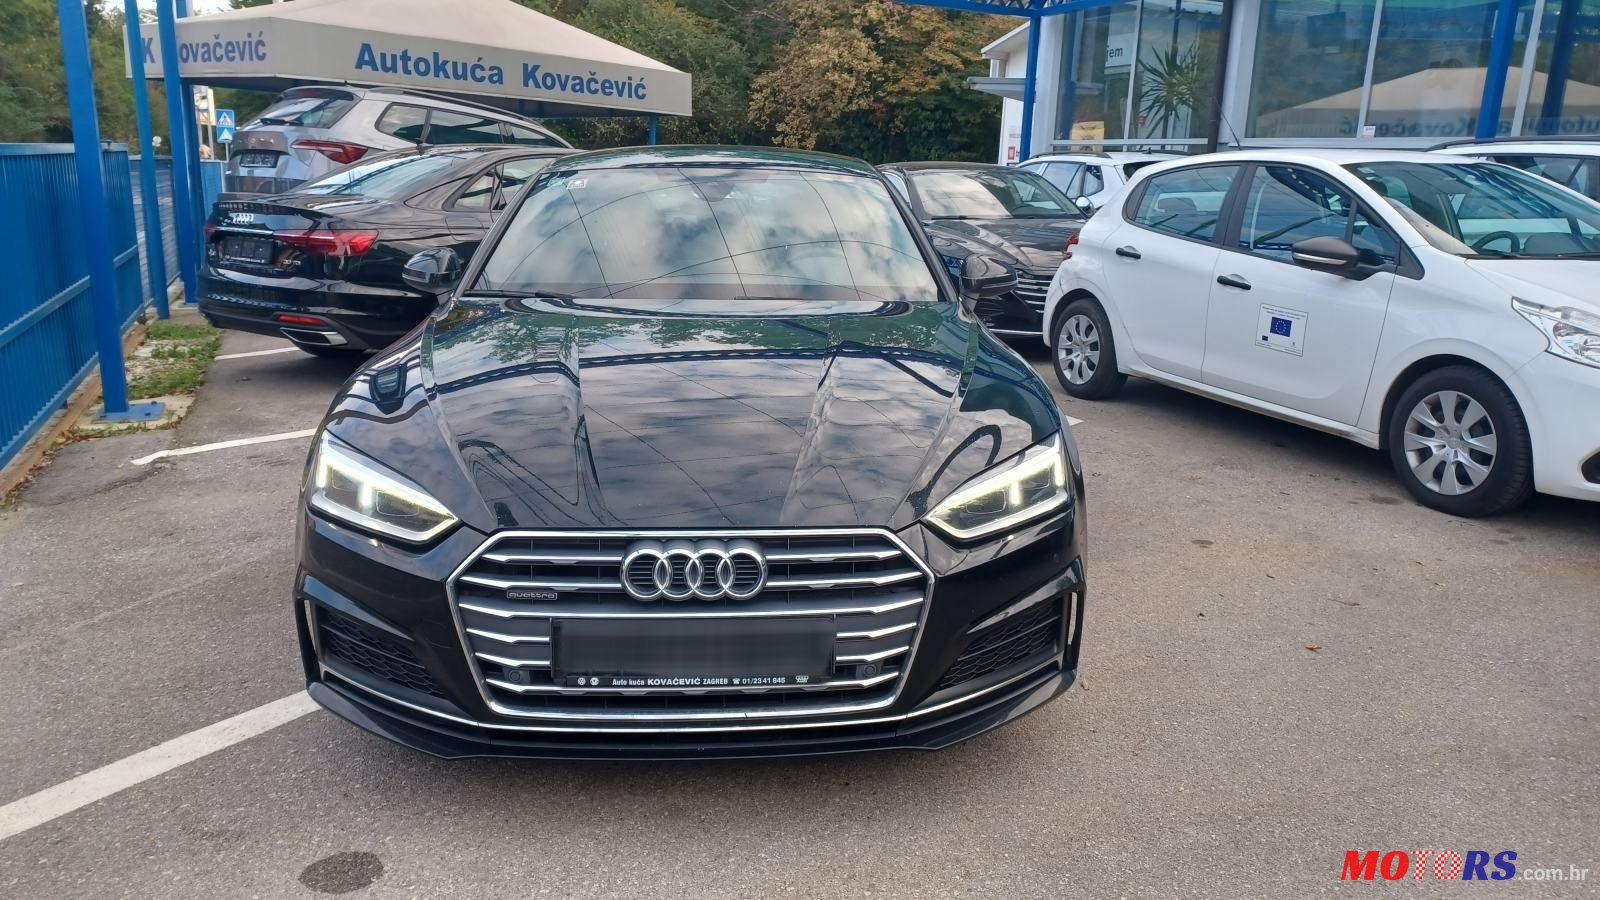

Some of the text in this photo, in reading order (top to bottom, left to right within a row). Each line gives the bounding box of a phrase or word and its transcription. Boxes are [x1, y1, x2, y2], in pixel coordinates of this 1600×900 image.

[354, 42, 647, 100] Autokuća Kovačević
[508, 591, 556, 599] quattro
[612, 677, 627, 686] Auto
[628, 677, 645, 686] kuća
[647, 676, 701, 686] KOVAČEVIĆ
